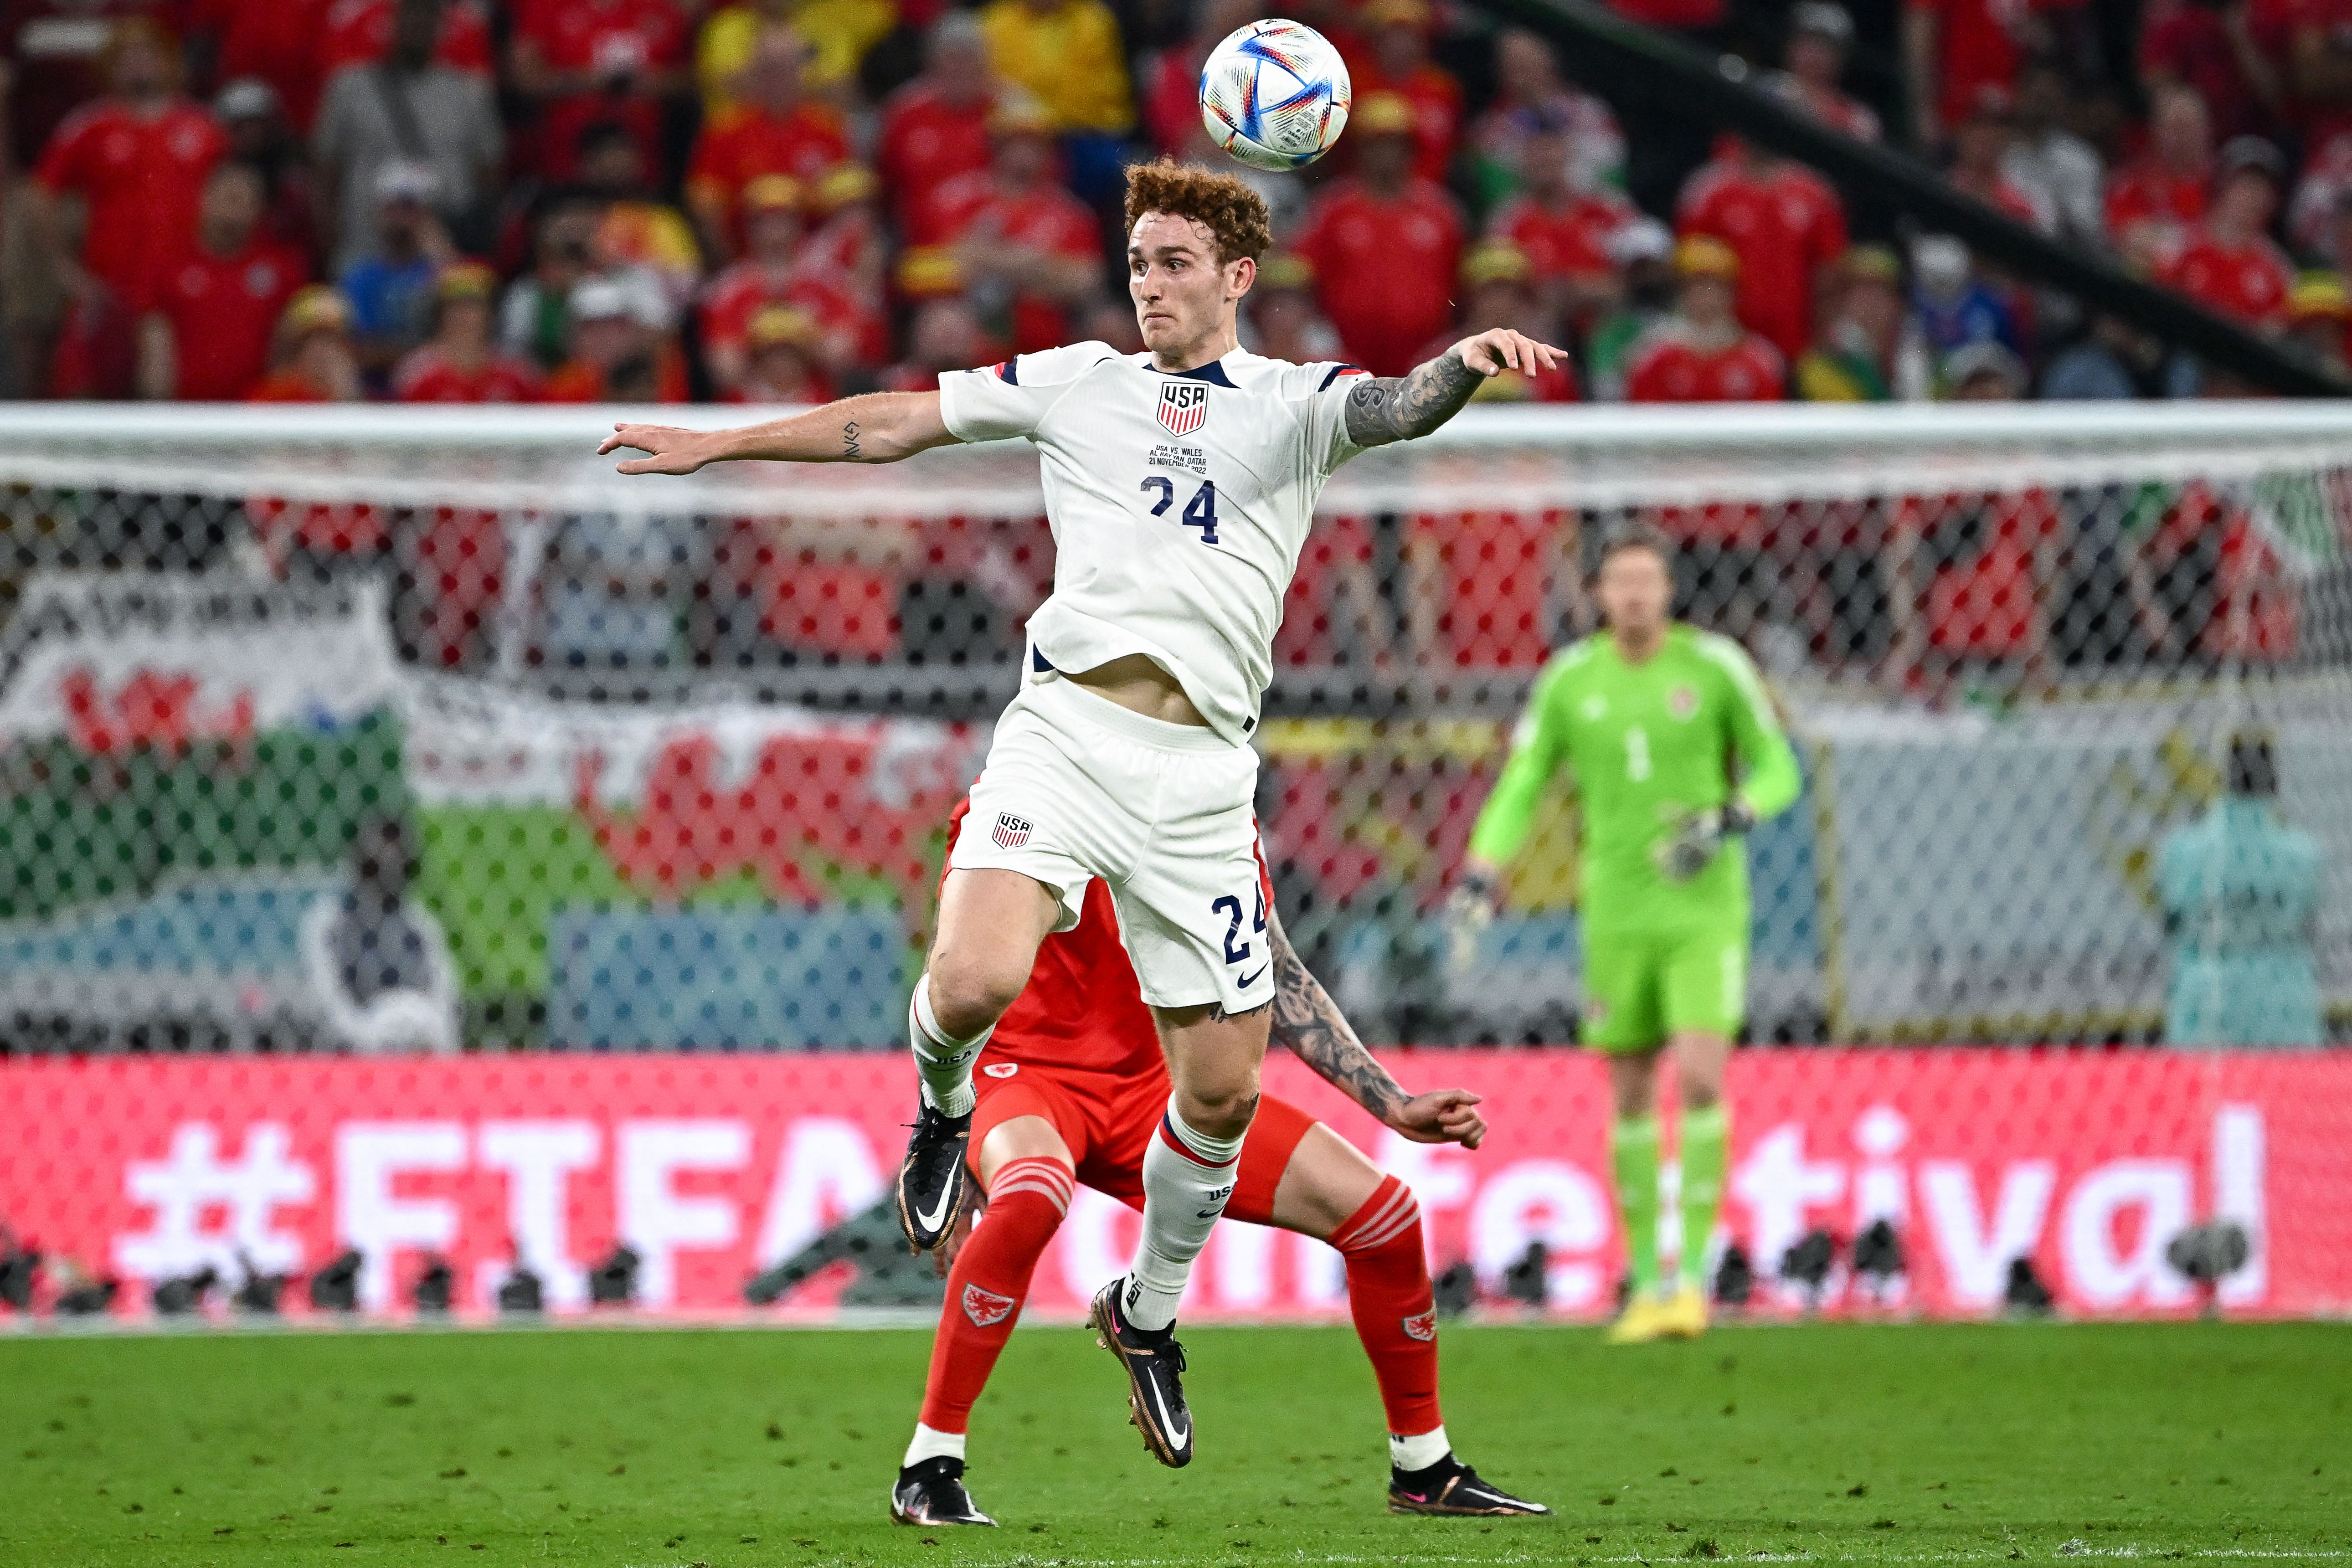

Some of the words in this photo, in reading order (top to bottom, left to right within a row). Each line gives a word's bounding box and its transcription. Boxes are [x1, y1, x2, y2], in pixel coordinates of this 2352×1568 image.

[1165, 386, 1204, 408] USA
[1181, 448, 1202, 456] WALES
[1187, 457, 1206, 466] QATAR
[1141, 476, 1219, 544] 24
[1000, 815, 1030, 831] USA
[1210, 1182, 1235, 1201] US
